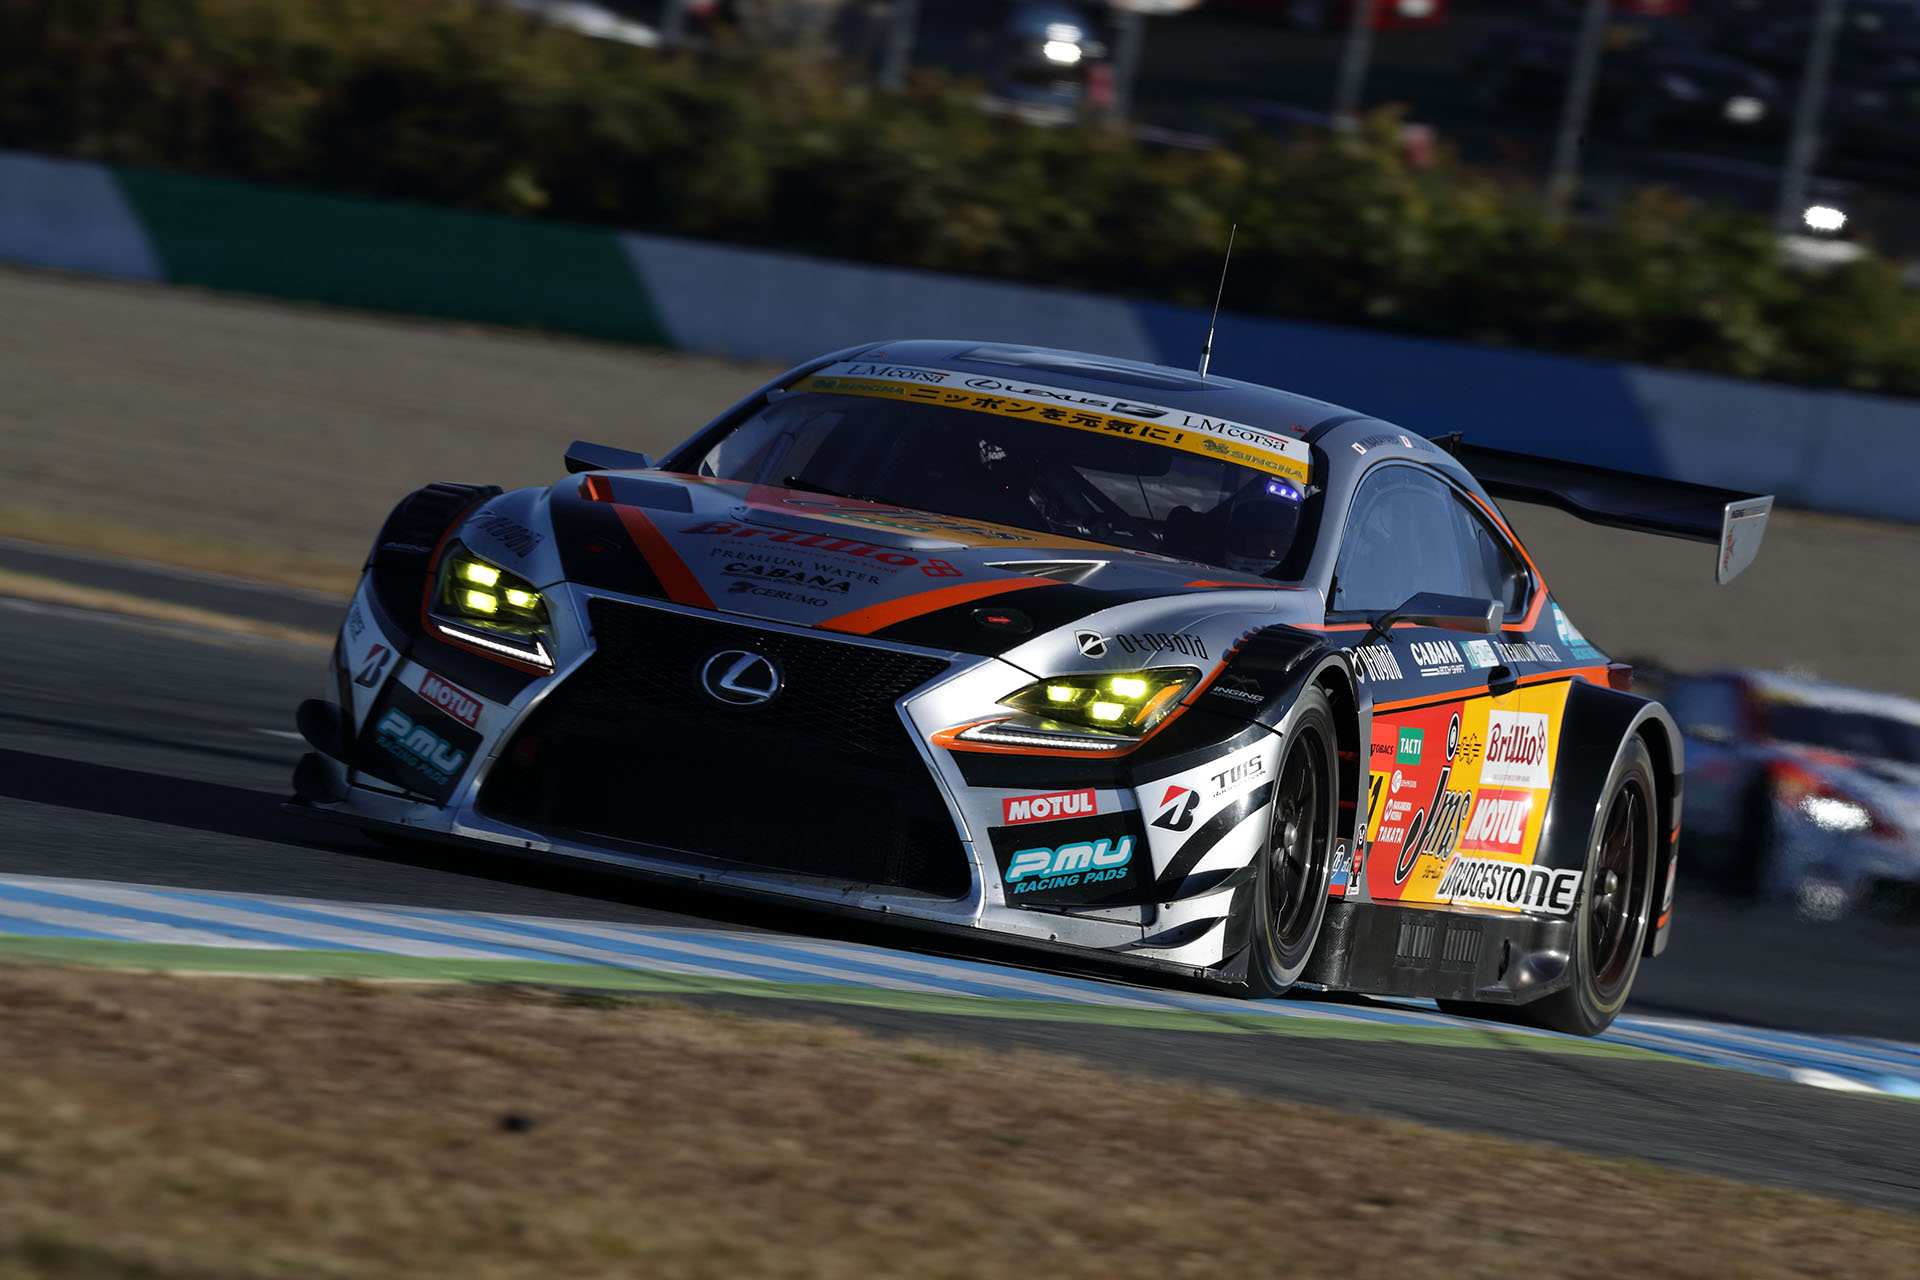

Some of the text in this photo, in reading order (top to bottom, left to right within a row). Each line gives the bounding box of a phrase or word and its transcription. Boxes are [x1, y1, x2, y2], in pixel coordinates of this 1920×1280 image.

[1005, 385, 1108, 407] LEXUS
[1229, 450, 1304, 479] SINGHA
[710, 547, 804, 572] PREMIUM
[813, 562, 880, 586] WATER
[723, 562, 852, 592] CABANA
[751, 586, 828, 607] CERUMO
[1410, 640, 1463, 667] CABANA
[421, 676, 479, 723] MOTUL
[1212, 686, 1265, 702] INGING
[1400, 738, 1421, 755] TACTI
[1486, 723, 1536, 766] Brillio
[1007, 792, 1093, 821] MOTUL
[1367, 775, 1383, 826] 1
[1377, 826, 1404, 844] TAKATA
[1465, 798, 1522, 844] MOTUL
[1013, 867, 1129, 895] RACING PADS
[1438, 857, 1575, 912] BRIDGESTONE
